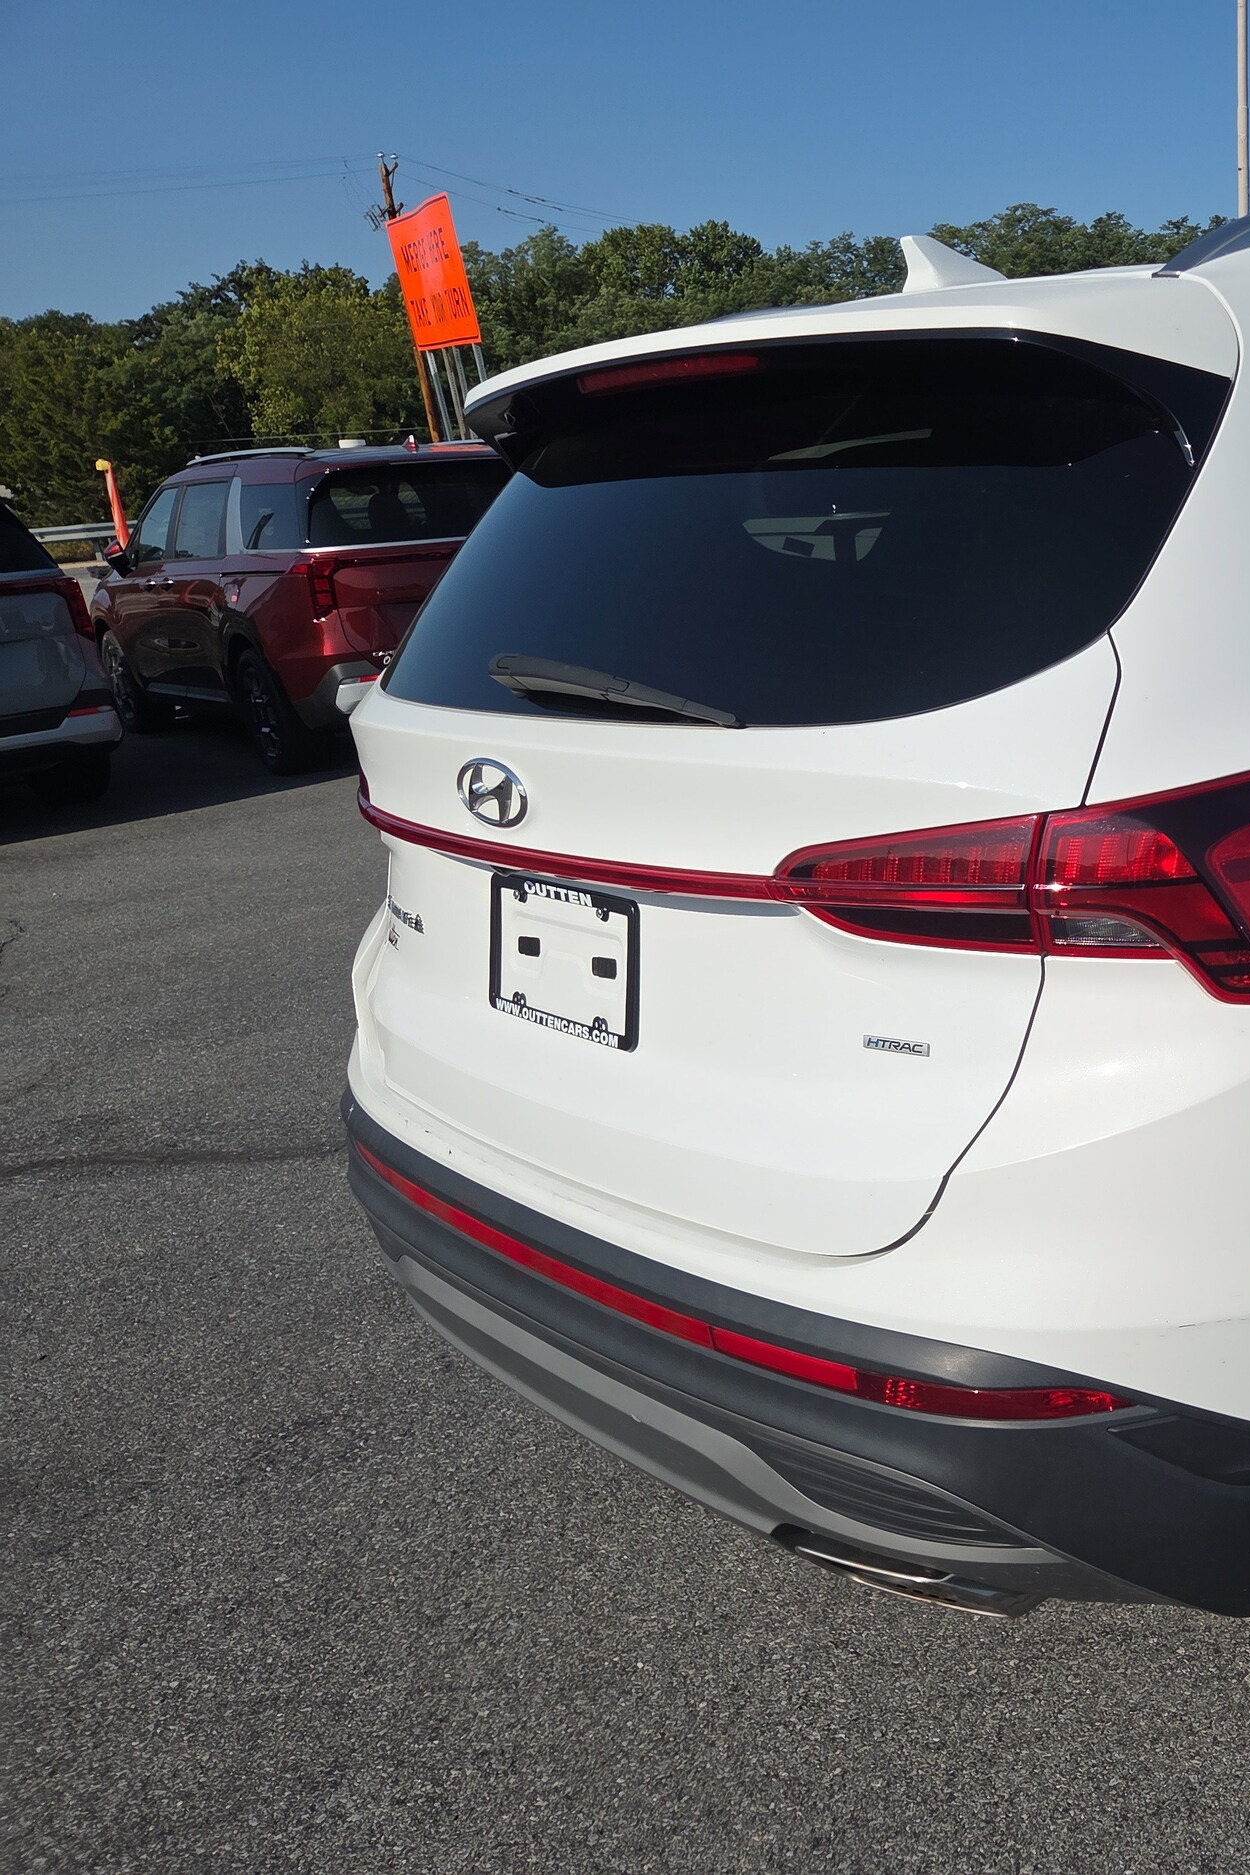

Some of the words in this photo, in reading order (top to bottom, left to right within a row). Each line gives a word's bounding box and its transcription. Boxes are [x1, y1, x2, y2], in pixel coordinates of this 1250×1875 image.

[410, 297, 432, 328] TAKE
[444, 286, 471, 319] TURN
[523, 880, 593, 907] OUTTEN
[495, 997, 619, 1049] WWW.OUTTENCARS.COM
[866, 1037, 924, 1054] HTRAC
